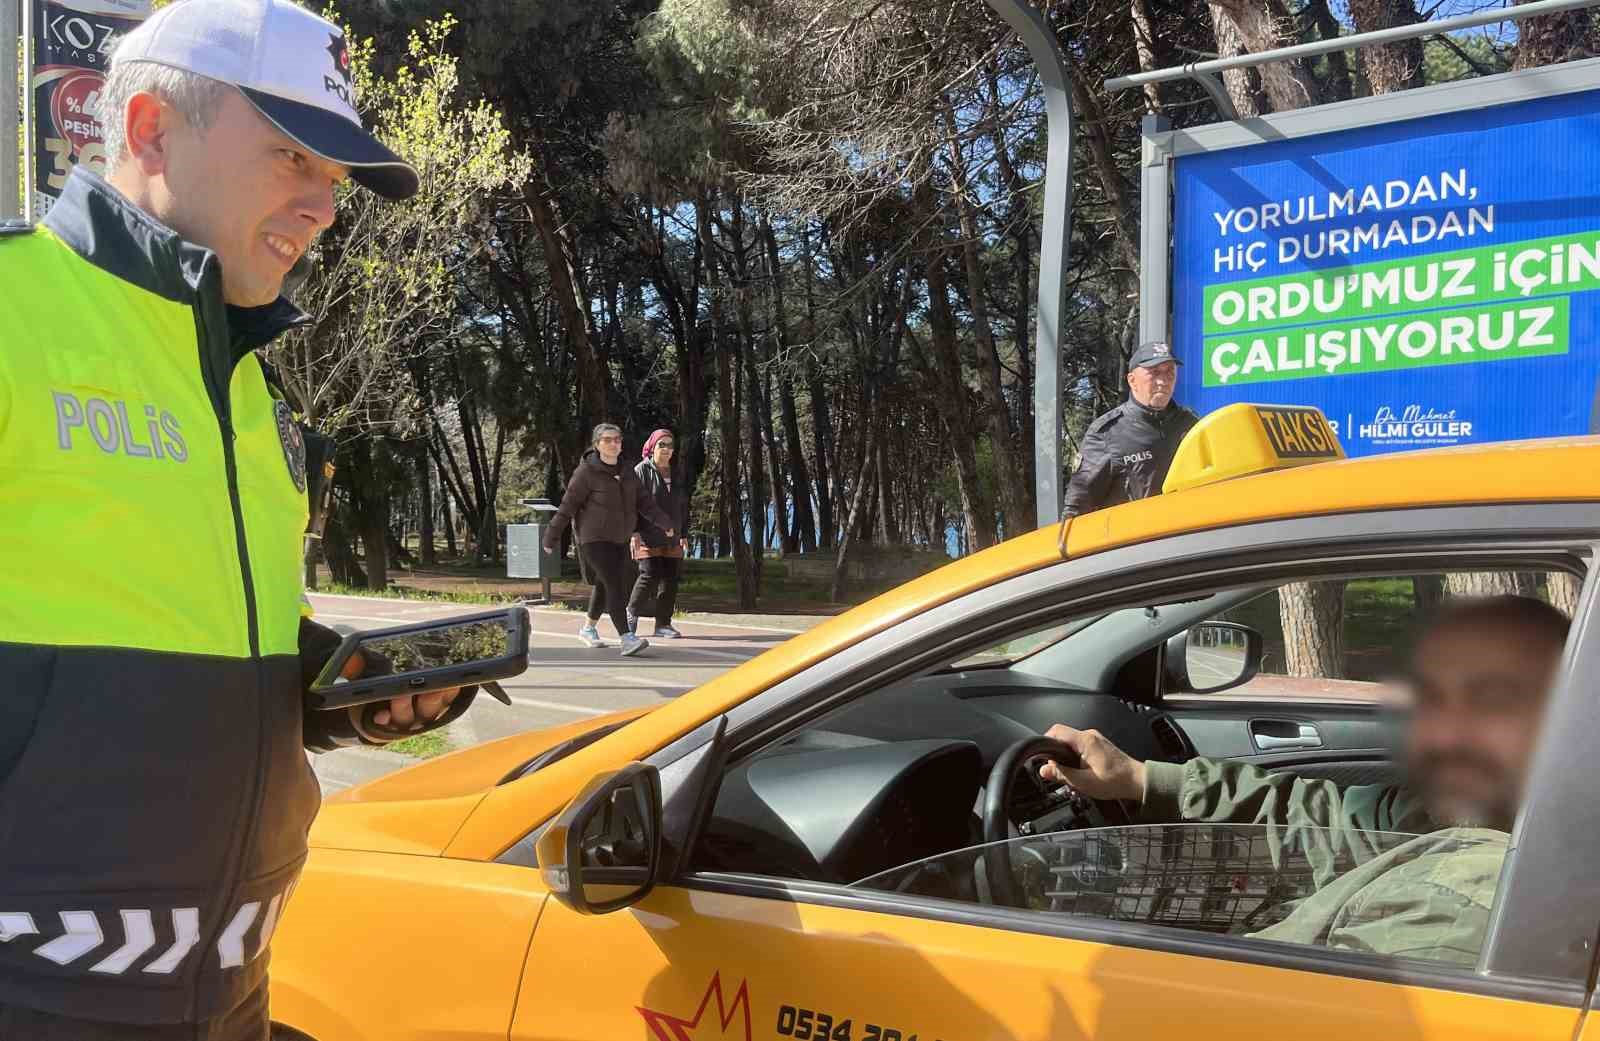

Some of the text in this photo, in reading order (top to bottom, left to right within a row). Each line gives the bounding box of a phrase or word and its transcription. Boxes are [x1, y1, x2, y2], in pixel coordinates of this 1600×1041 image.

[1213, 168, 1478, 237] YORULMADAN,
[1278, 205, 1495, 266] DURMADAN
[1210, 306, 1555, 384] ÇALIŞIYORUZ
[776, 1004, 852, 1041] 0534
